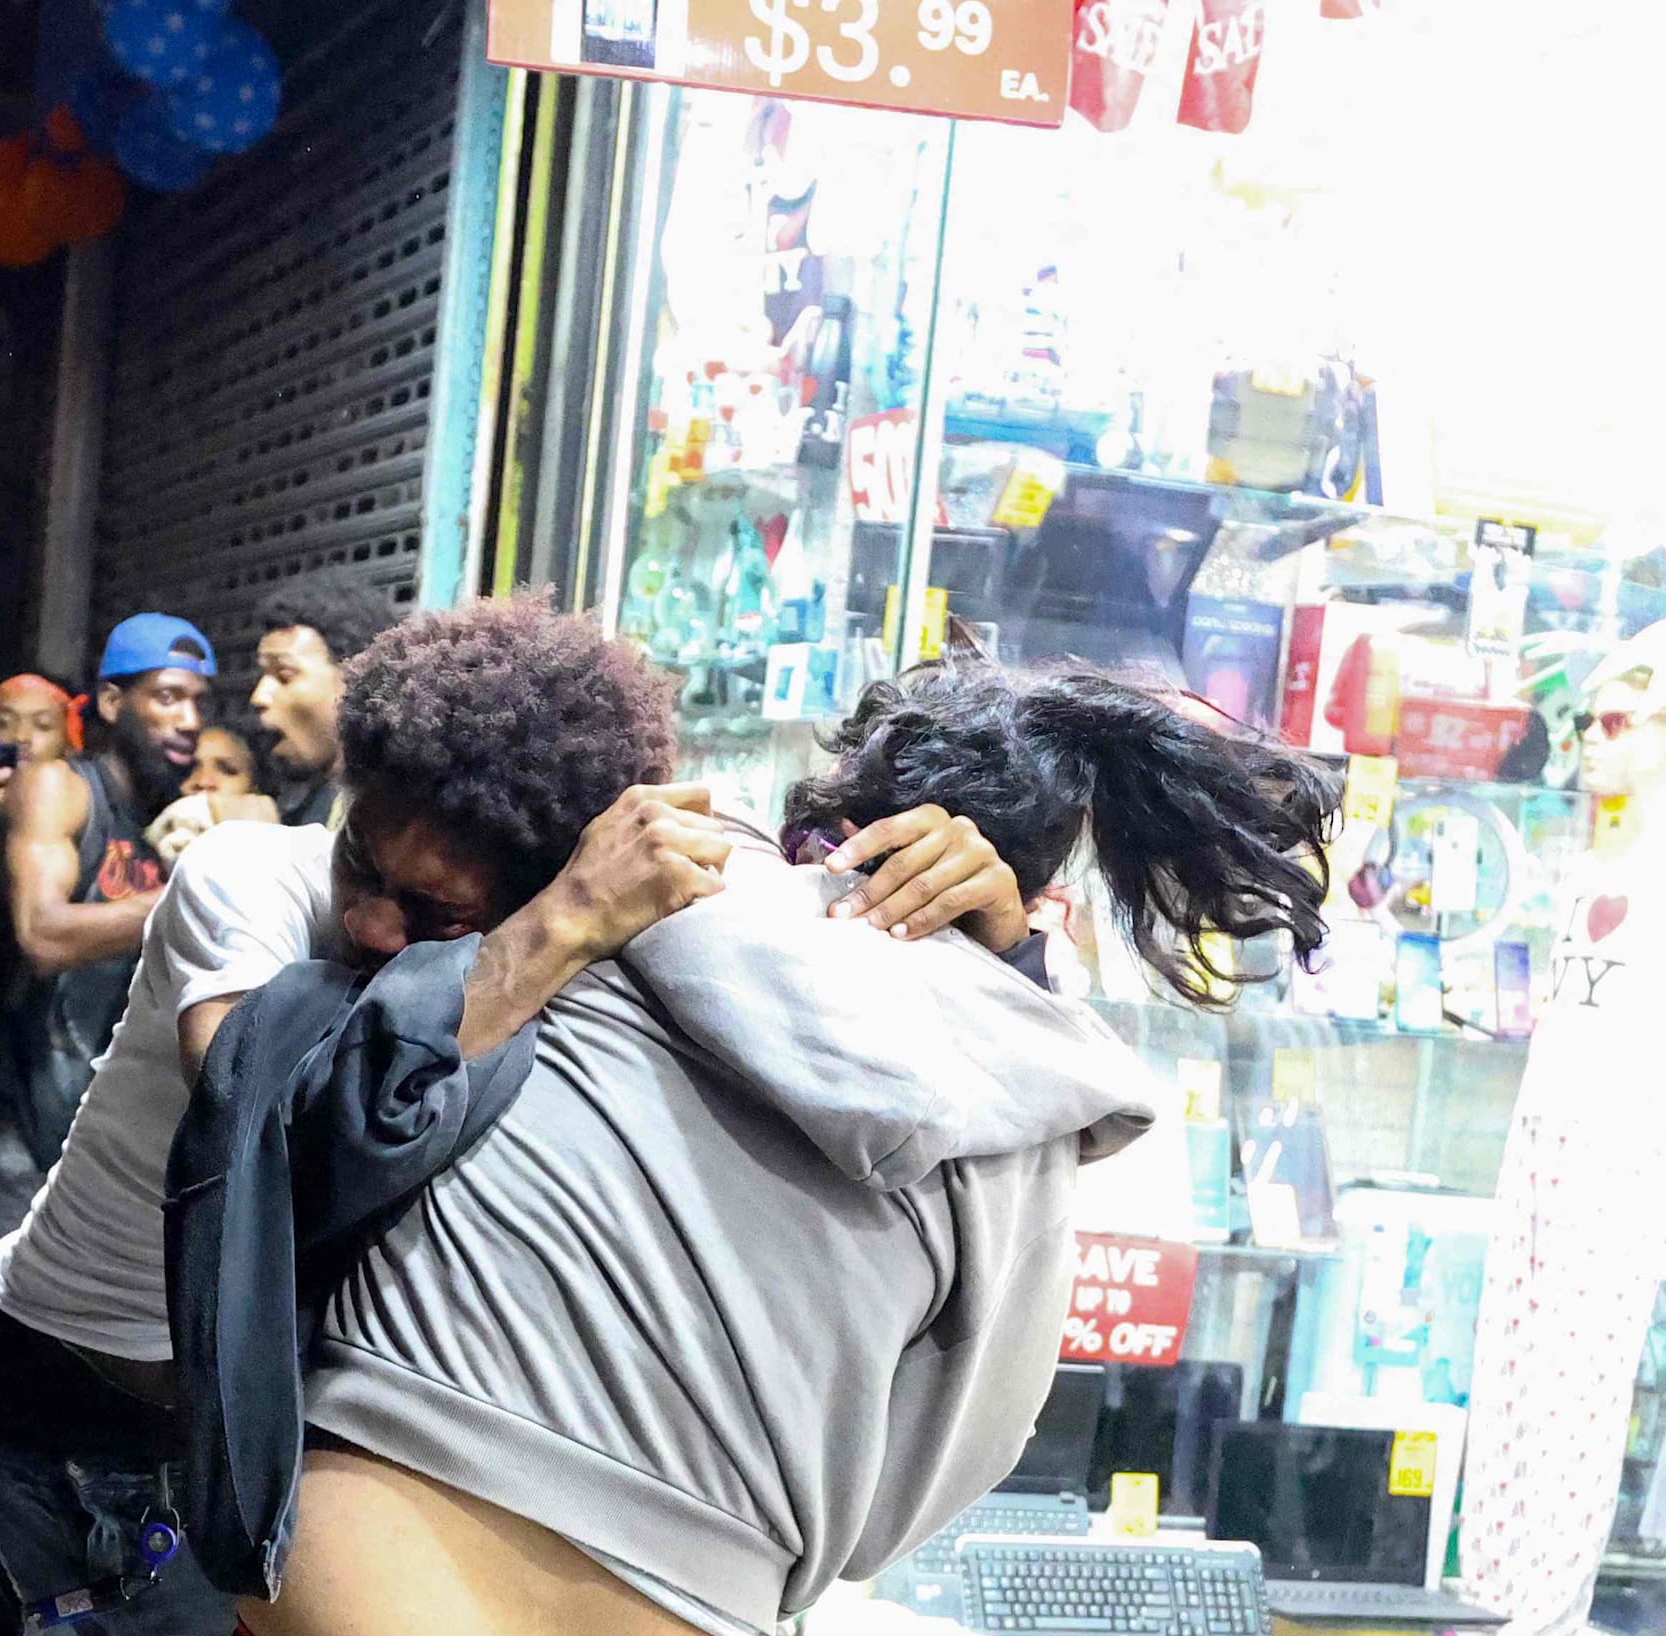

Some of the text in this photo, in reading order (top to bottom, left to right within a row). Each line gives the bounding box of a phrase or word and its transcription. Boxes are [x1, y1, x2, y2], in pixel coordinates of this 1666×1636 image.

[1193, 3, 1264, 74] SAL
[1000, 69, 1050, 103] EA.
[1108, 1321, 1179, 1358] OFF
